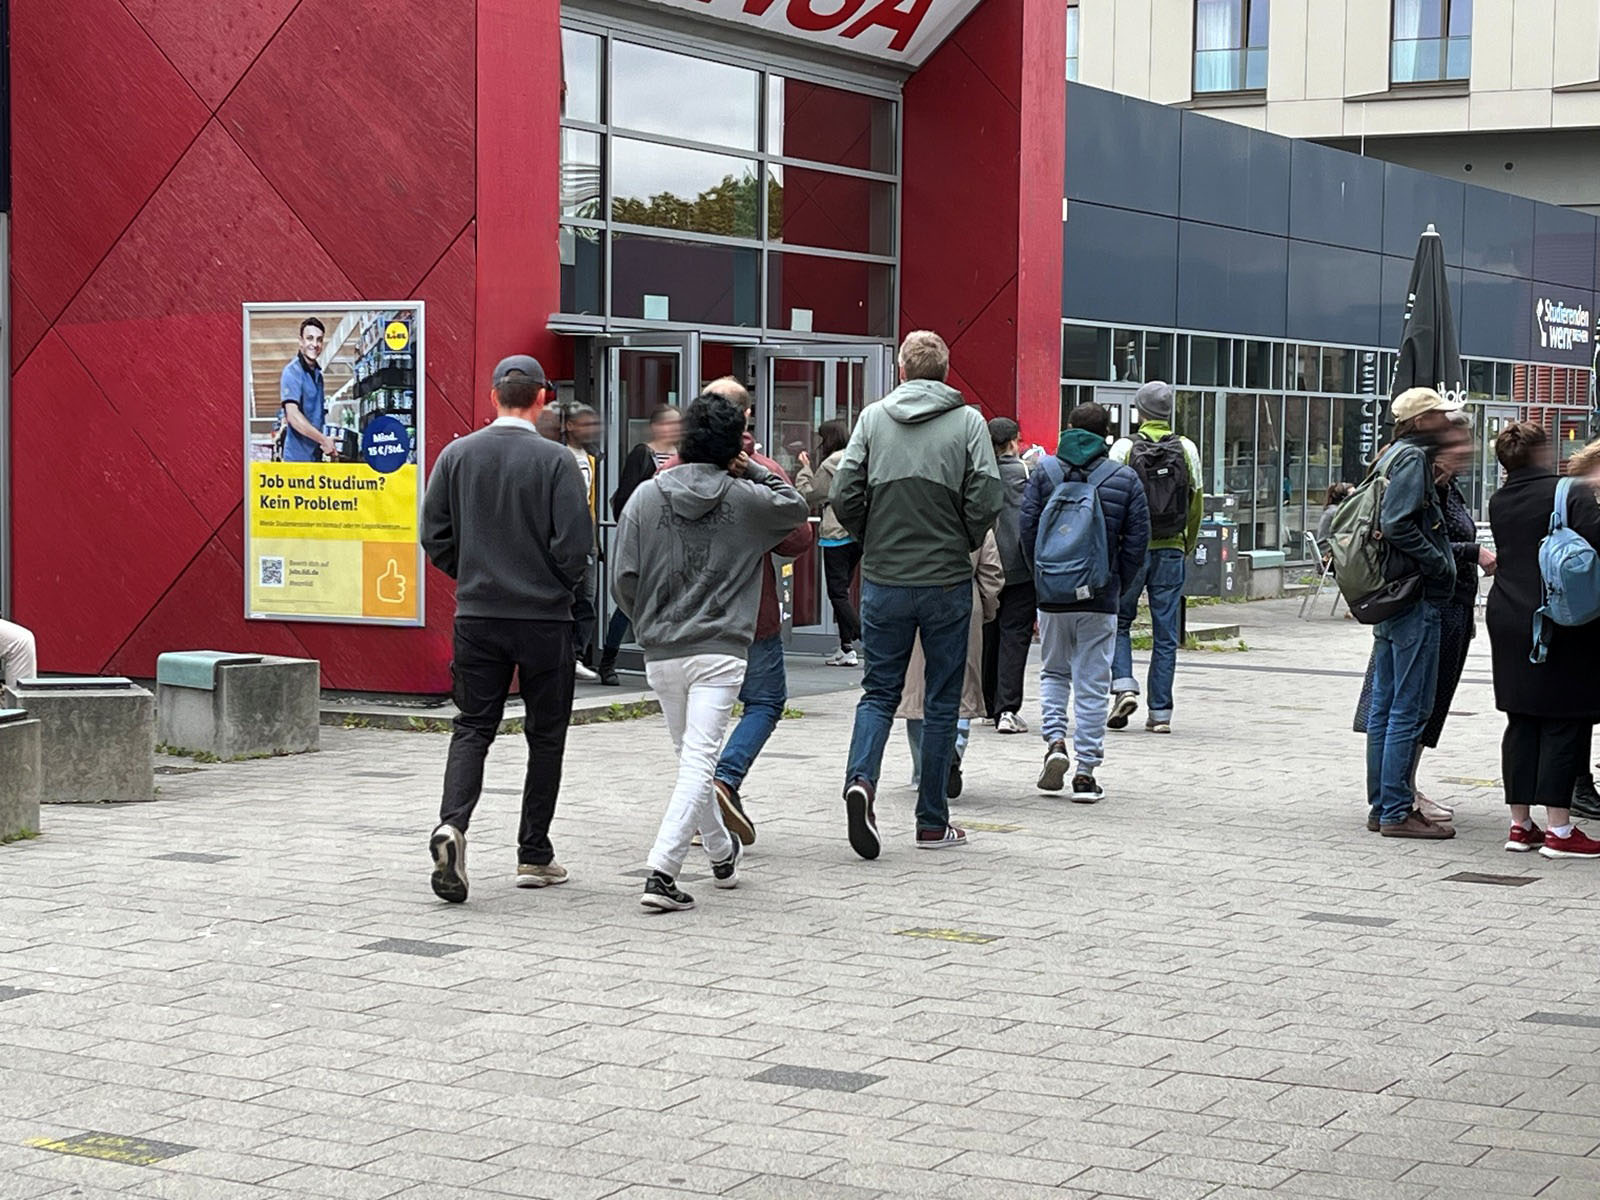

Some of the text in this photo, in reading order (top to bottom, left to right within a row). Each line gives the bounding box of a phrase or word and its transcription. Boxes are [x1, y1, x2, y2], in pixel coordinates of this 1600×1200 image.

[373, 432, 398, 443] Mind.
[259, 474, 386, 491] Job und Studium?
[260, 494, 358, 511] Kein Problem!
